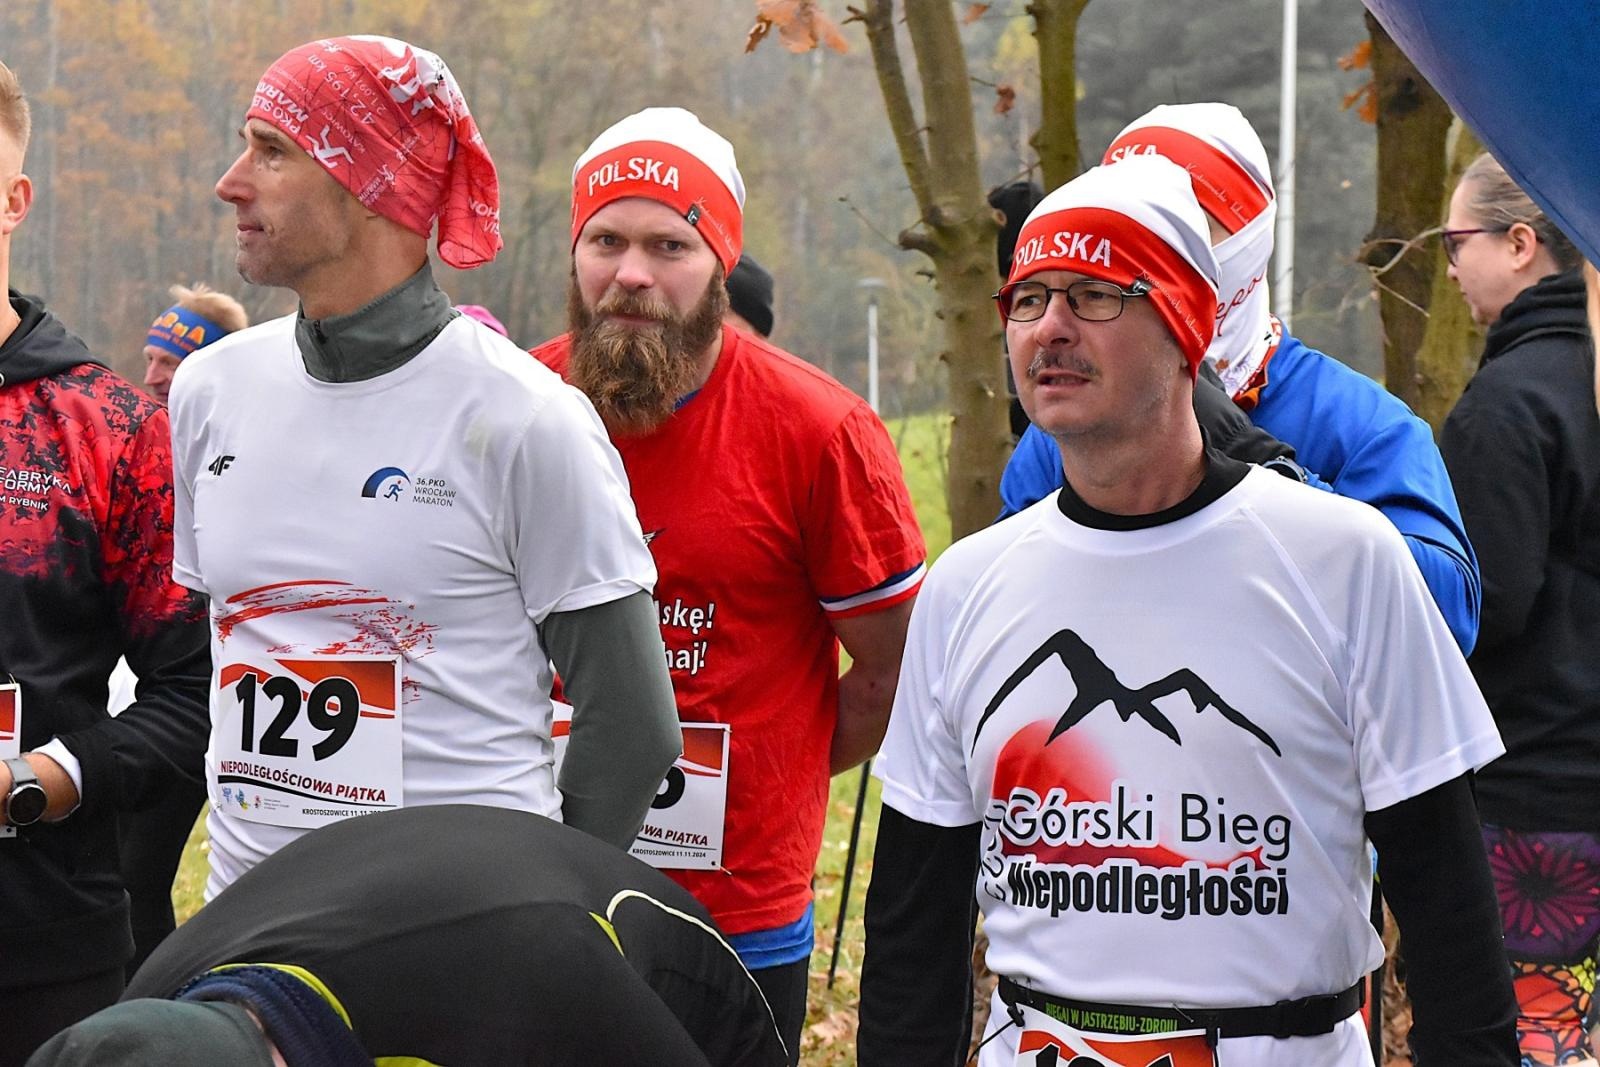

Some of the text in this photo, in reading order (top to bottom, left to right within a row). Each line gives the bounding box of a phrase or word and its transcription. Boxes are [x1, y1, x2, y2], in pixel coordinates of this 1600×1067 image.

[588, 156, 680, 197] POLSKA
[1013, 231, 1112, 276] POLSKA
[208, 455, 236, 476] 4F
[412, 495, 454, 507] MARATON
[414, 486, 457, 498] WROCŁAW
[9, 496, 49, 511] RYBNIK
[235, 672, 360, 762] 129
[220, 760, 387, 803] NIEPODLEGŁOŚCIOWA PIĄTKA
[302, 808, 350, 817] KROSTOSZOWICE
[1002, 785, 1292, 861] Górski Bieg
[665, 830, 708, 846] PIĄTKA
[632, 848, 675, 857] KROSTOSZOWICE
[1006, 862, 1290, 921] Niepodległości
[1045, 1002, 1069, 1025] BIEGAJ
[1070, 1007, 1080, 1024] W
